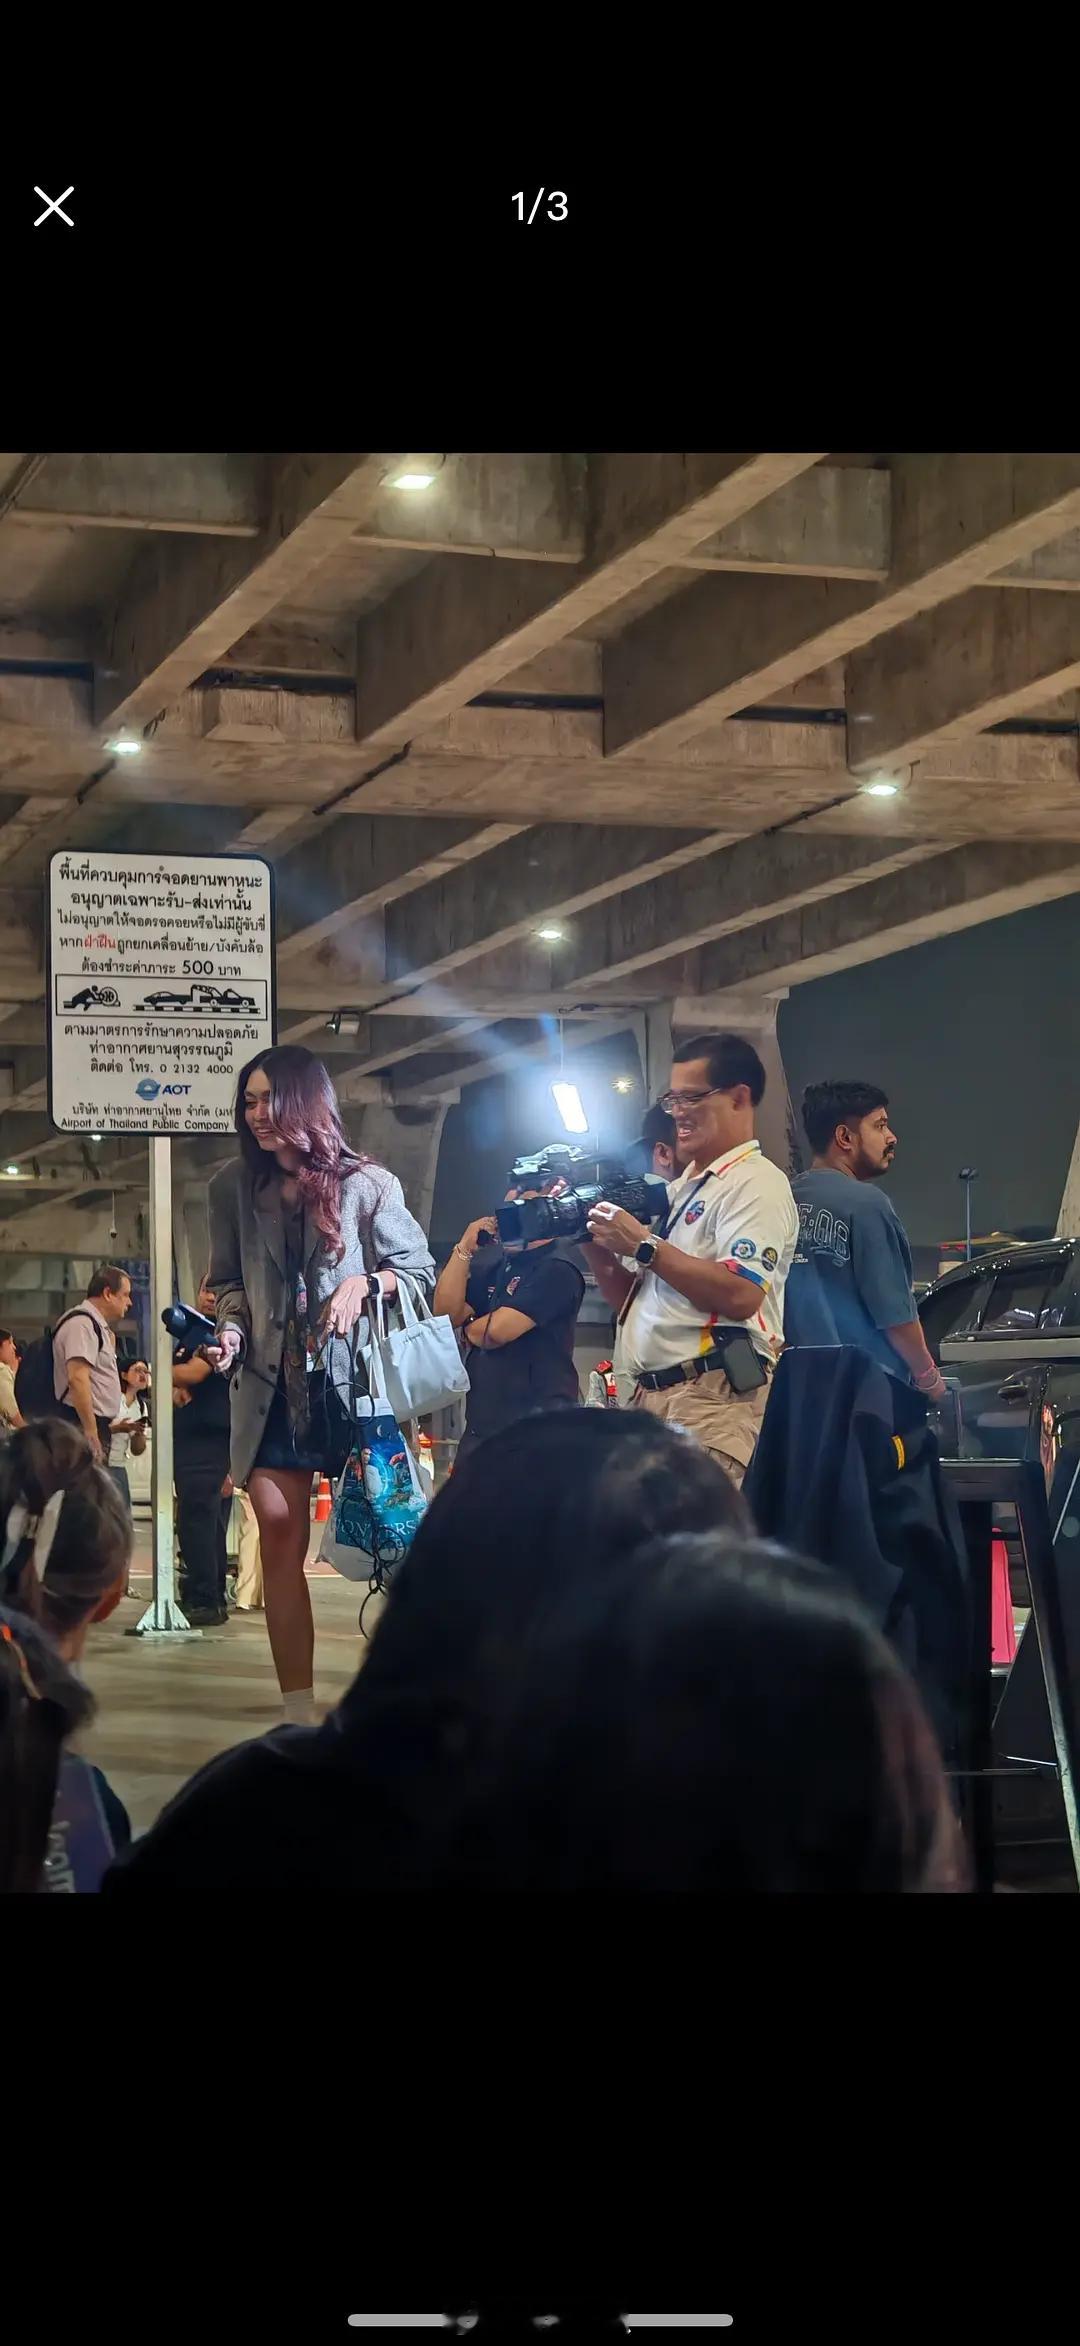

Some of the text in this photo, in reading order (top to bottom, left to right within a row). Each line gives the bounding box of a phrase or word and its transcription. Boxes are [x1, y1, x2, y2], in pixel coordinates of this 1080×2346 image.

[182, 960, 214, 975] 500
[217, 965, 242, 976] บาท
[64, 1022, 259, 1039] ตามมาตรการรักษาความปลอดภัย
[89, 1040, 233, 1061] ท่าอากาศยานสุวรรณภูมิ
[90, 1057, 233, 1074] ติดต่อ โทร. 0 2132 4000
[162, 1084, 192, 1095] AOT
[72, 1102, 98, 1115] บริษัท
[104, 1102, 182, 1116] ท่าอากาศยานไทย
[186, 1104, 210, 1116] จำกัด
[61, 1118, 229, 1131] Airport of Thailand Public Company
